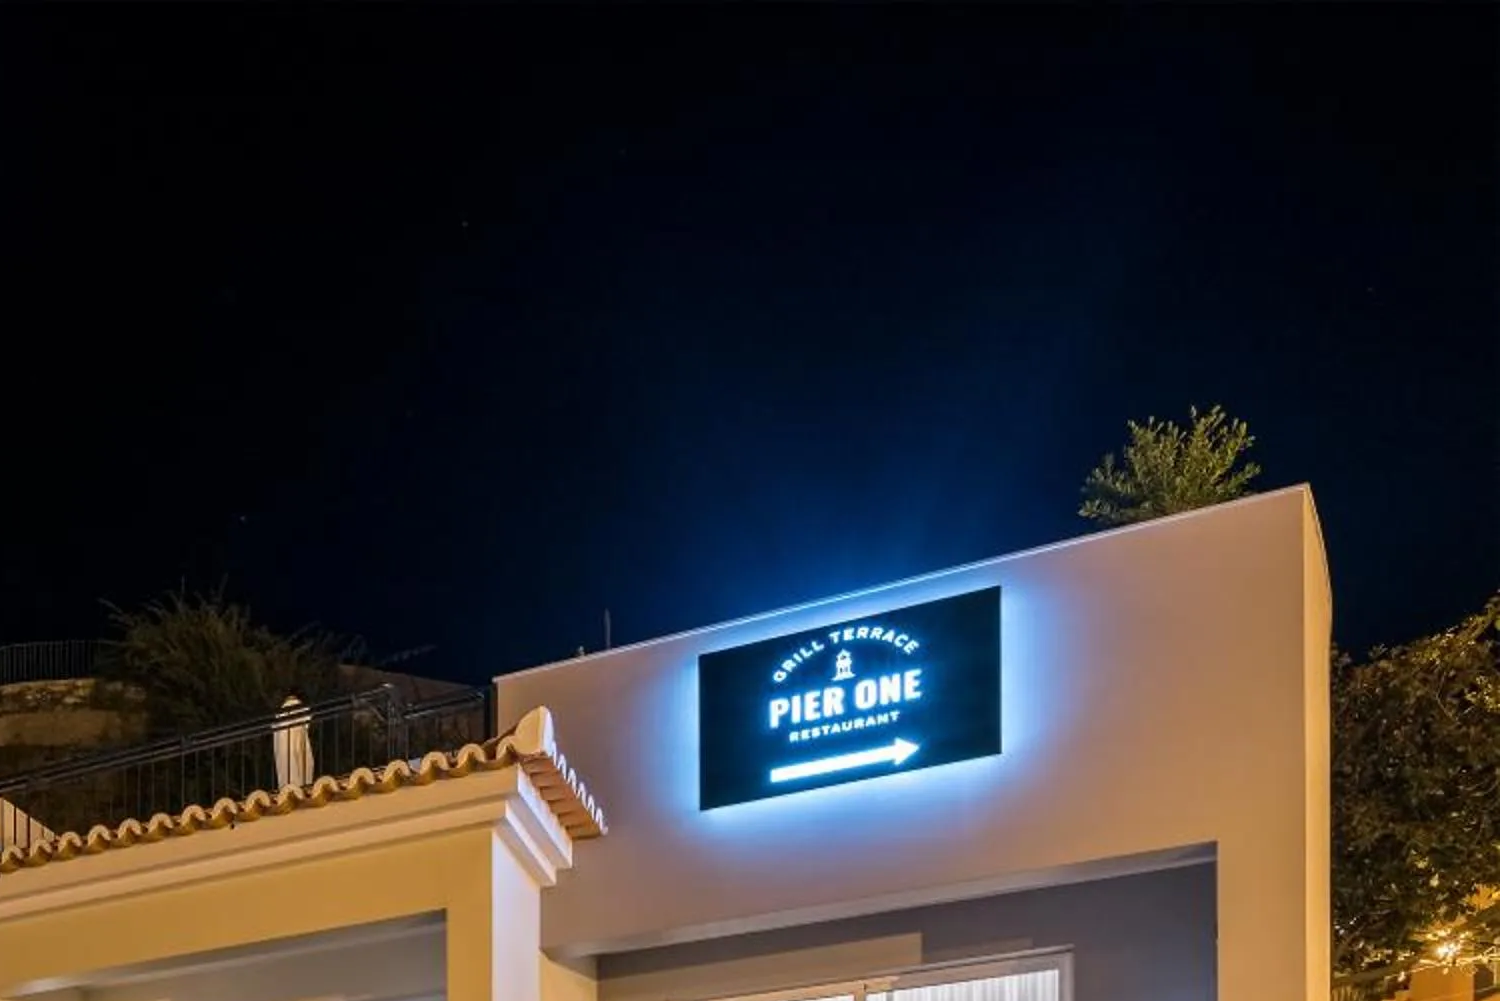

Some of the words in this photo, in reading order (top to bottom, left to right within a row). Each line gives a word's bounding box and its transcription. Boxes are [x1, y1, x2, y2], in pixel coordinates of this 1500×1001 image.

[773, 641, 825, 683] GRILL
[829, 626, 920, 655] TERRACE
[769, 687, 845, 729] PIER
[855, 669, 922, 710] ONE
[789, 711, 901, 743] RESTAURANT
